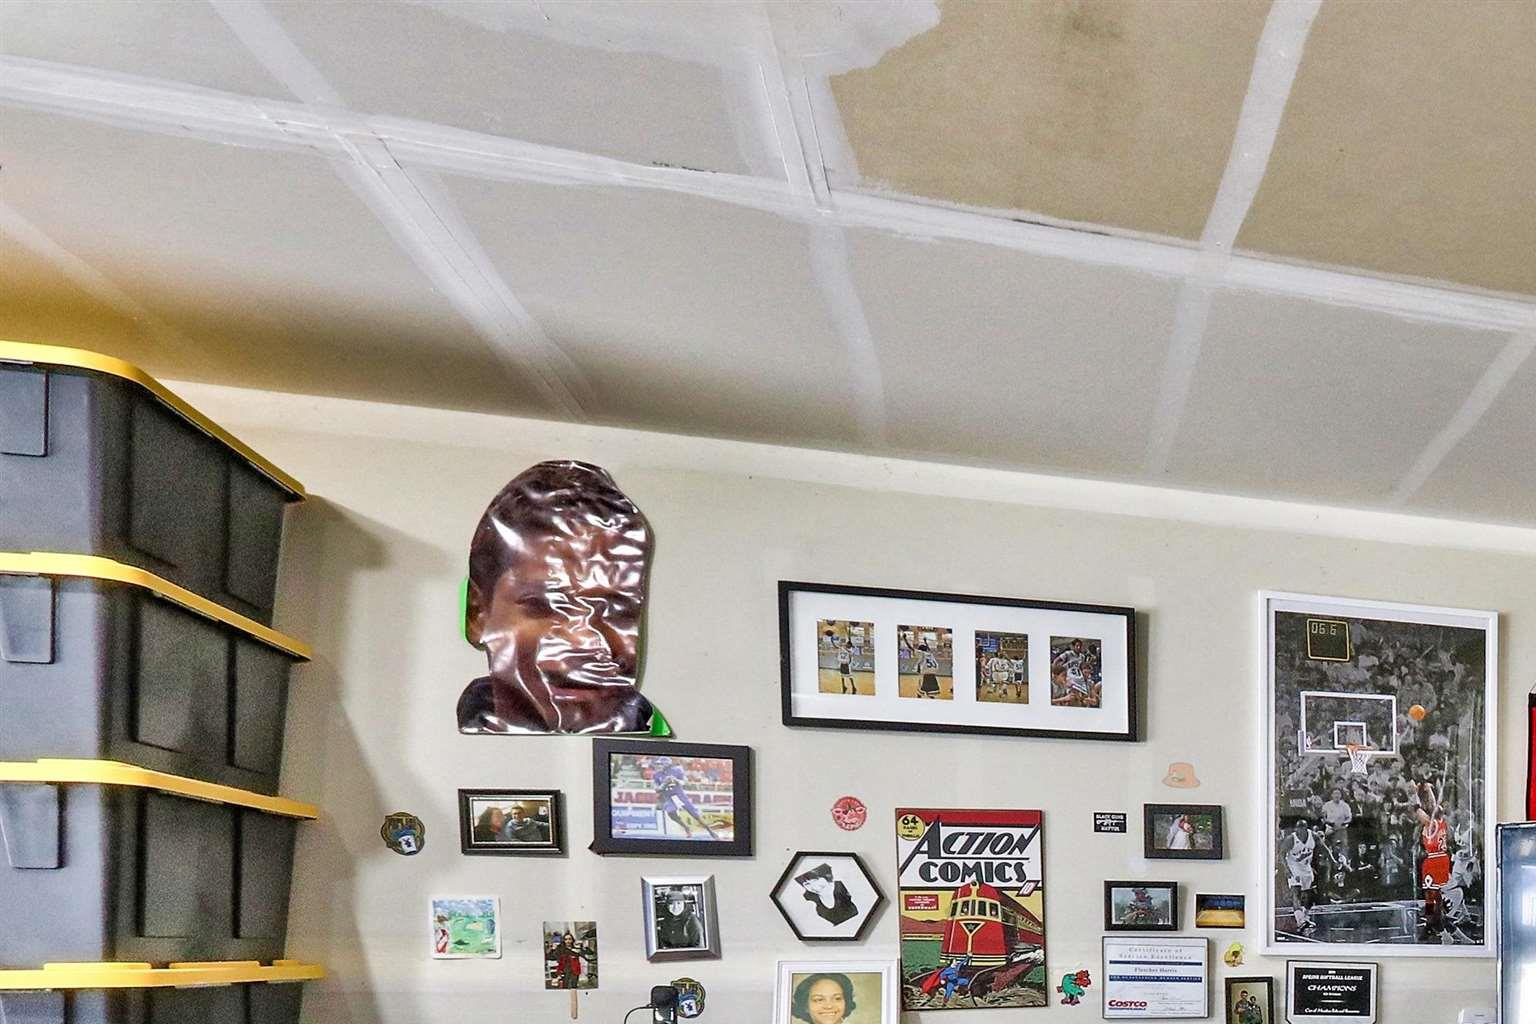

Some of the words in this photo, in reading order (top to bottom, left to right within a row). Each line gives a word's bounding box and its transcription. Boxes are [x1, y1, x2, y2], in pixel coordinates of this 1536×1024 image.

[902, 816, 919, 826] 64
[899, 815, 1041, 876] ACTION
[918, 861, 1027, 883] COMICS
[1307, 984, 1357, 992] CHAMPIONS
[1108, 999, 1148, 1008] COSTCO
